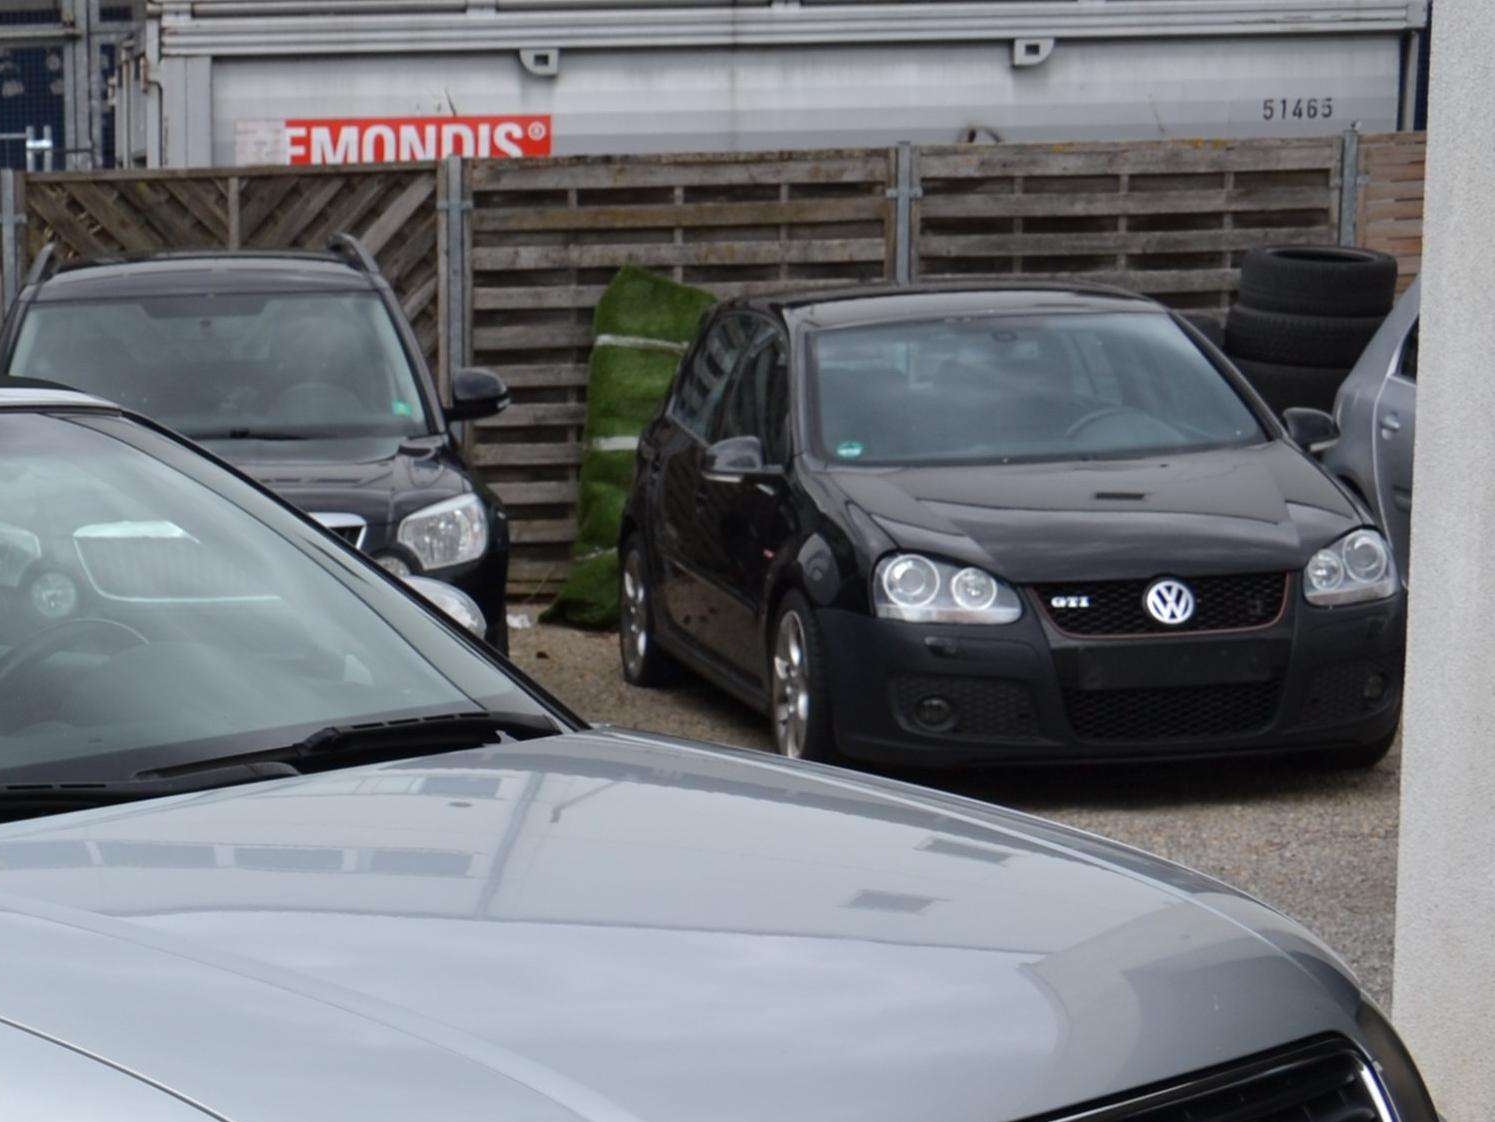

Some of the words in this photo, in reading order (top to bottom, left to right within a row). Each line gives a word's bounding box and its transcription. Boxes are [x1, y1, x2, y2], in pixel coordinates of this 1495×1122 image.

[1263, 98, 1333, 120] 51465
[1051, 596, 1090, 608] GTI
[1146, 580, 1195, 624] VW
